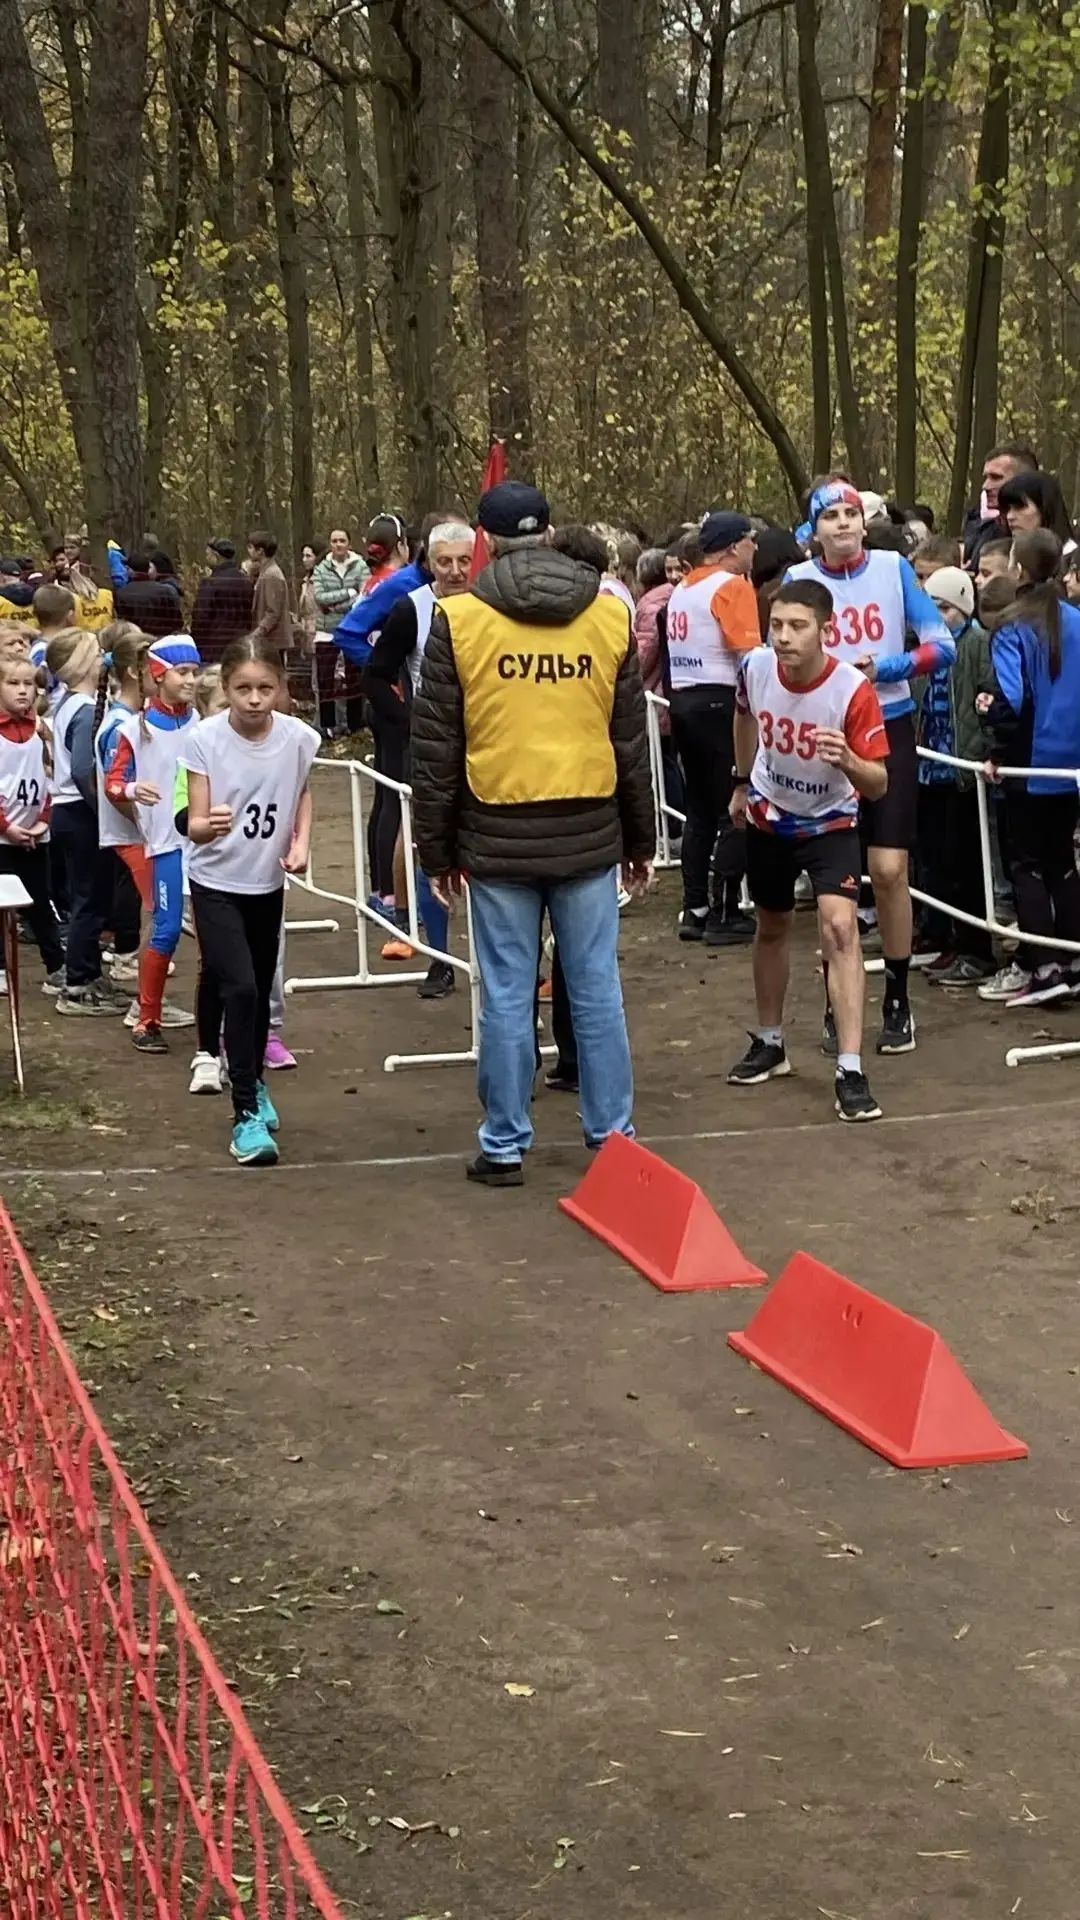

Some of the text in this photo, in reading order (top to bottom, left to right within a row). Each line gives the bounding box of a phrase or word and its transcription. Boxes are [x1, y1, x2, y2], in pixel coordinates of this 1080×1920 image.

[498, 654, 592, 684] СУДЬЯ
[759, 711, 817, 760] 335
[17, 778, 40, 807] 42
[243, 803, 277, 839] 35
